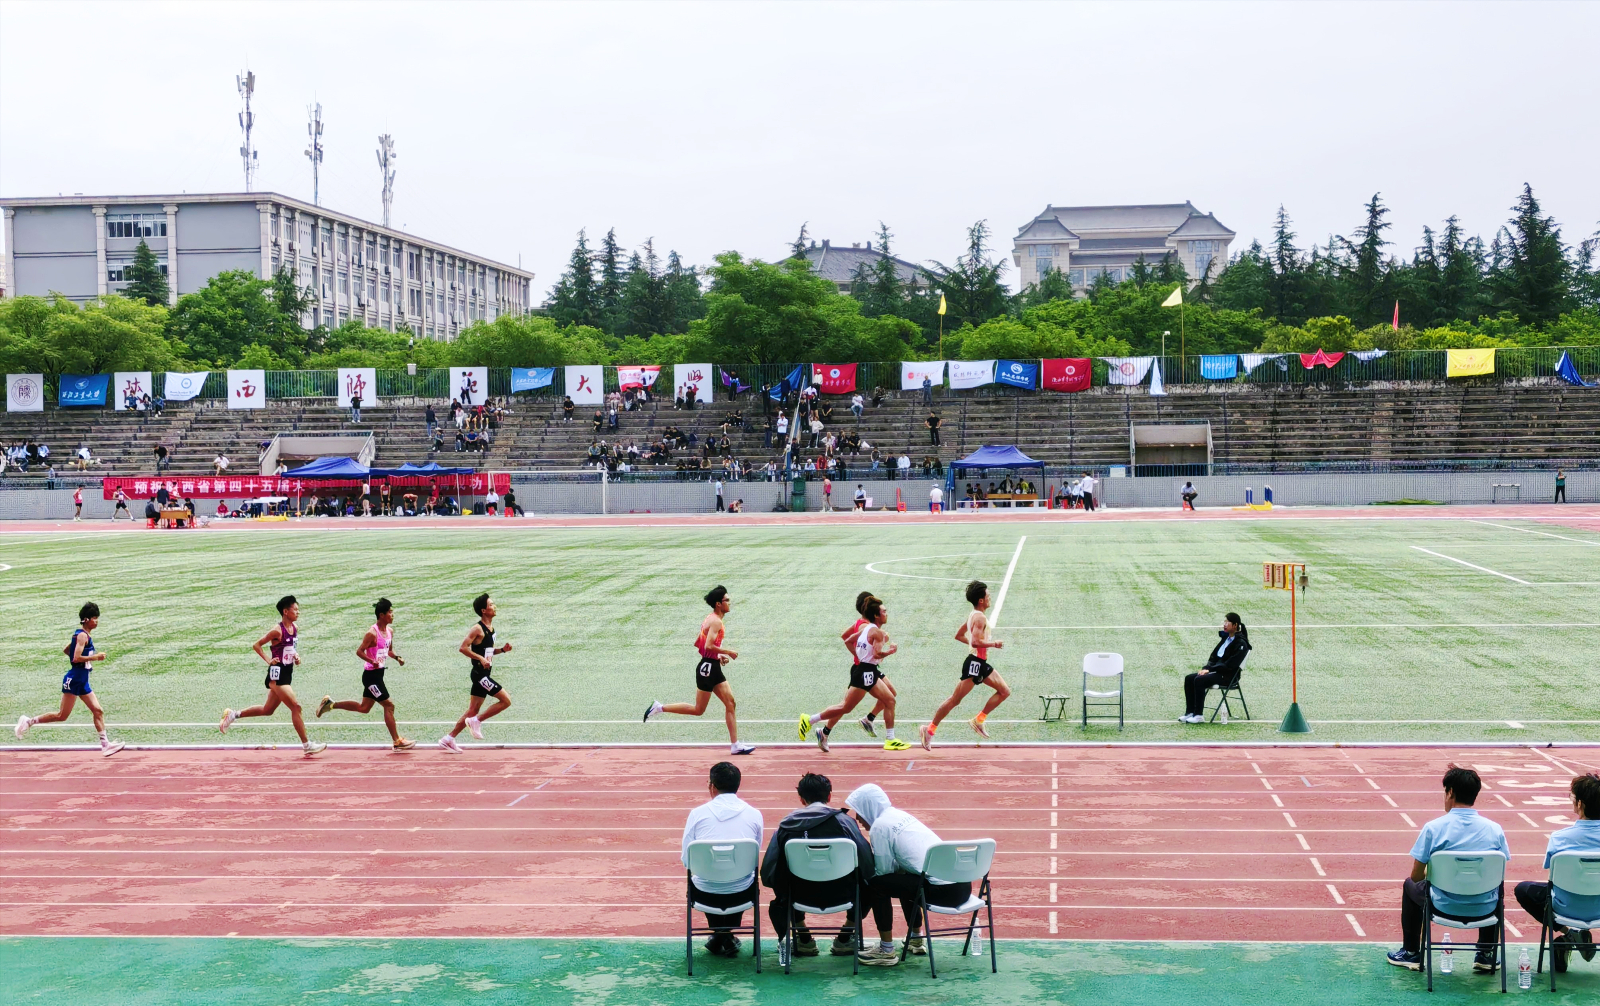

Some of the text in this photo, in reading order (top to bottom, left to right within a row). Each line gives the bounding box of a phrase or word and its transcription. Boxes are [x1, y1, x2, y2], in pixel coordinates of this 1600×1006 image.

[237, 379, 256, 398] 西
[576, 374, 592, 394] 大
[271, 668, 279, 678] 15
[702, 664, 711, 675] 4
[970, 663, 980, 674] 10
[481, 679, 492, 690] 12
[864, 674, 873, 685] 13
[1471, 764, 1554, 772] 2
